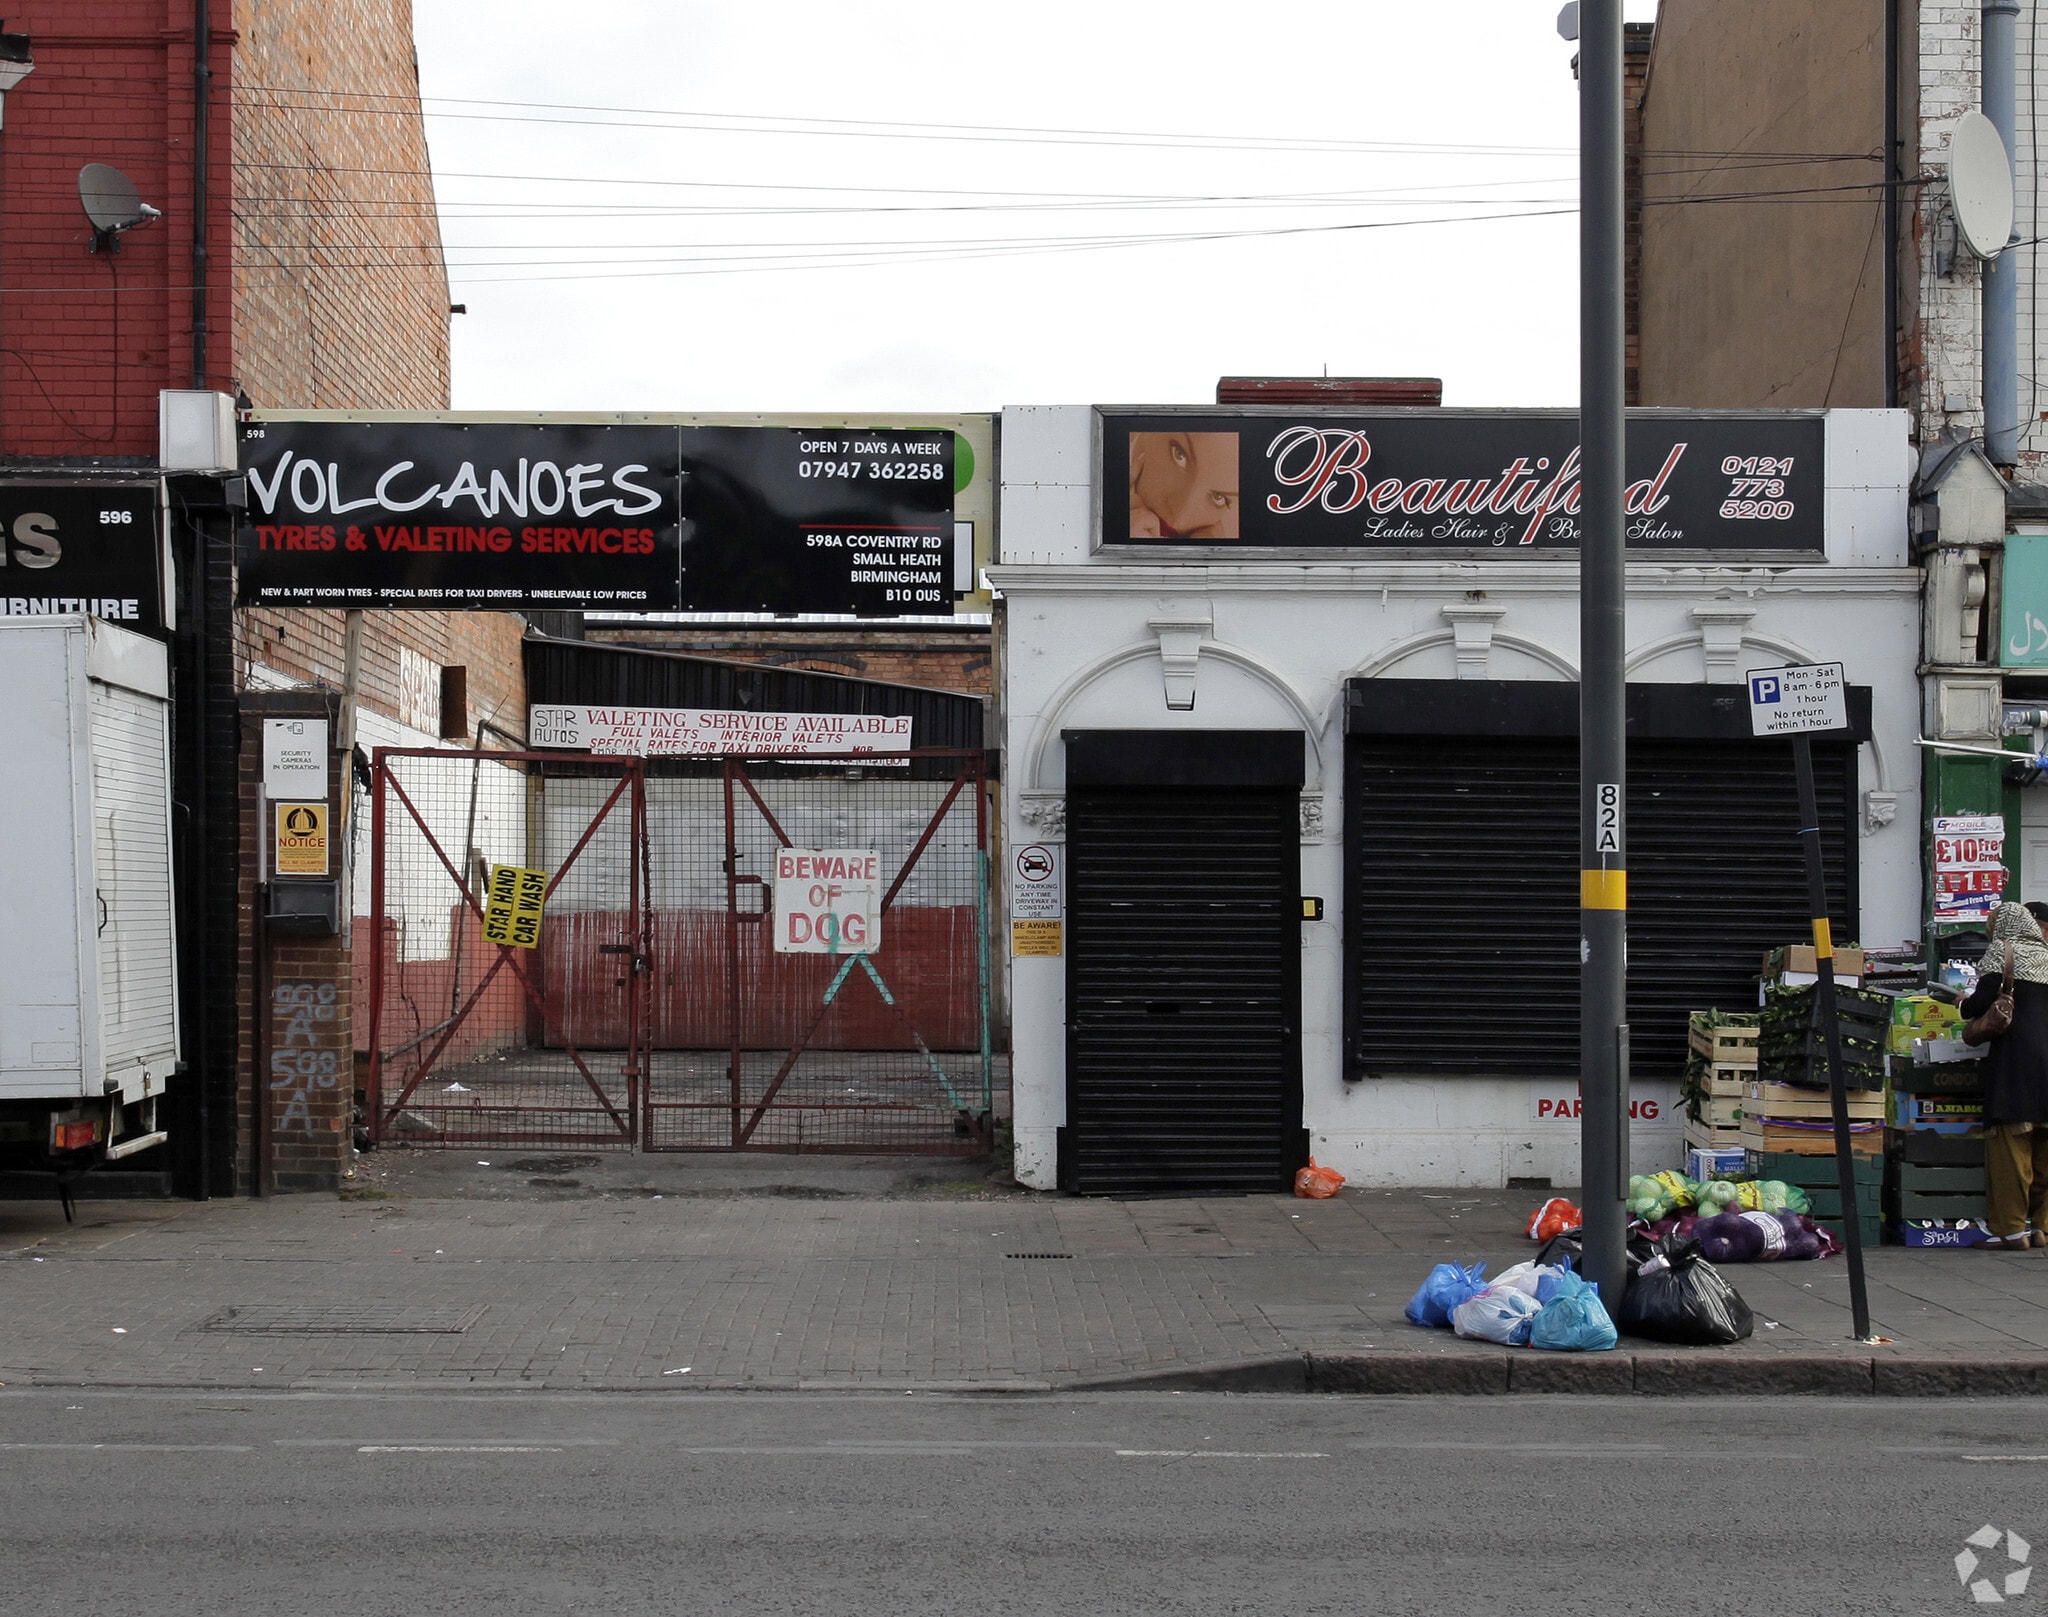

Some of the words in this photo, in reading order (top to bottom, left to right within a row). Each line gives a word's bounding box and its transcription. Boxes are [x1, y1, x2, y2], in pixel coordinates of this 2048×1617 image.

[246, 429, 265, 439] 598
[800, 441, 837, 454] OPEN
[842, 442, 850, 454] 7
[854, 442, 888, 455] DAYS
[890, 443, 902, 455] A
[904, 443, 942, 455] WEEK
[799, 461, 862, 478] 07947
[869, 462, 944, 480] 362258
[1720, 455, 1795, 476] 0121
[248, 450, 663, 518] VOLCANOES
[1727, 478, 1785, 498] 773
[99, 510, 133, 524] 596
[1719, 499, 1795, 520] 5200
[0, 512, 62, 569] S
[255, 525, 337, 551] TYRES
[344, 525, 368, 551] &
[374, 526, 513, 552] VALETING
[521, 526, 656, 554] SERVICES
[806, 534, 843, 547] 598A
[846, 535, 919, 548] COVENTRY
[922, 536, 942, 549] RD
[1364, 516, 1425, 539] Ladies
[1431, 518, 1488, 539] Hair
[1492, 521, 1515, 547] &
[1626, 517, 1684, 540] Salon
[853, 552, 896, 566] SMALL
[900, 553, 942, 566] HEATH
[851, 570, 942, 583] BIRMINGHAM
[261, 587, 282, 597] NEW
[283, 588, 291, 597] &
[293, 588, 314, 597] PART
[315, 588, 345, 597] WORN
[347, 588, 373, 598] TYRES
[380, 588, 416, 598] SPECIAL
[417, 589, 444, 598] RATES
[445, 589, 464, 598] FOR
[466, 589, 485, 598] TAXI
[486, 589, 523, 599] DRIVERS
[530, 590, 591, 599] UNBELIEVABLE
[593, 590, 615, 599] LOW
[616, 590, 647, 600] PRICES
[886, 589, 912, 601] B10
[1786, 671, 1808, 680] Mon
[1816, 668, 1835, 678] Sat
[1758, 679, 1776, 702] P
[1783, 683, 1790, 692] 8
[1792, 683, 1807, 691] am
[1815, 680, 1822, 689] 6
[1824, 681, 1840, 690] pm
[1797, 695, 1801, 703] 1
[1804, 694, 1828, 703] hour
[534, 709, 578, 728] STAR
[586, 710, 687, 727] VALETING
[699, 712, 788, 731] SERVICE
[795, 716, 909, 734] AVAILABLE
[1774, 711, 1789, 719] No
[1792, 708, 1825, 718] return
[1766, 720, 1799, 731] within
[1801, 719, 1806, 727] 1
[1809, 717, 1833, 727] hour
[534, 728, 579, 744] AUTOS
[590, 738, 640, 749] SPECIAL
[648, 740, 689, 750] RATES
[691, 741, 717, 752] FOR
[721, 742, 750, 752] TAXI
[755, 744, 808, 753] DRIVERS
[611, 727, 643, 738] FULL
[650, 728, 700, 740] VALETS
[720, 730, 783, 742] INTERIOR
[792, 733, 844, 744] VALETS
[279, 837, 326, 847] NOTICE
[1936, 838, 1978, 863] £10
[779, 856, 877, 880] BEWARE
[493, 869, 517, 904] HAND
[518, 872, 545, 911] WASH
[809, 884, 843, 907] OF
[486, 907, 512, 940] STAR
[513, 916, 538, 944] CAR
[788, 912, 866, 945] DOG
[1013, 921, 1025, 929] BE
[1027, 921, 1062, 929] AWARE!
[284, 1008, 318, 1047] A
[270, 1048, 337, 1092] 598
[279, 1087, 314, 1138] A
[1538, 1098, 1659, 1120] PARNG
